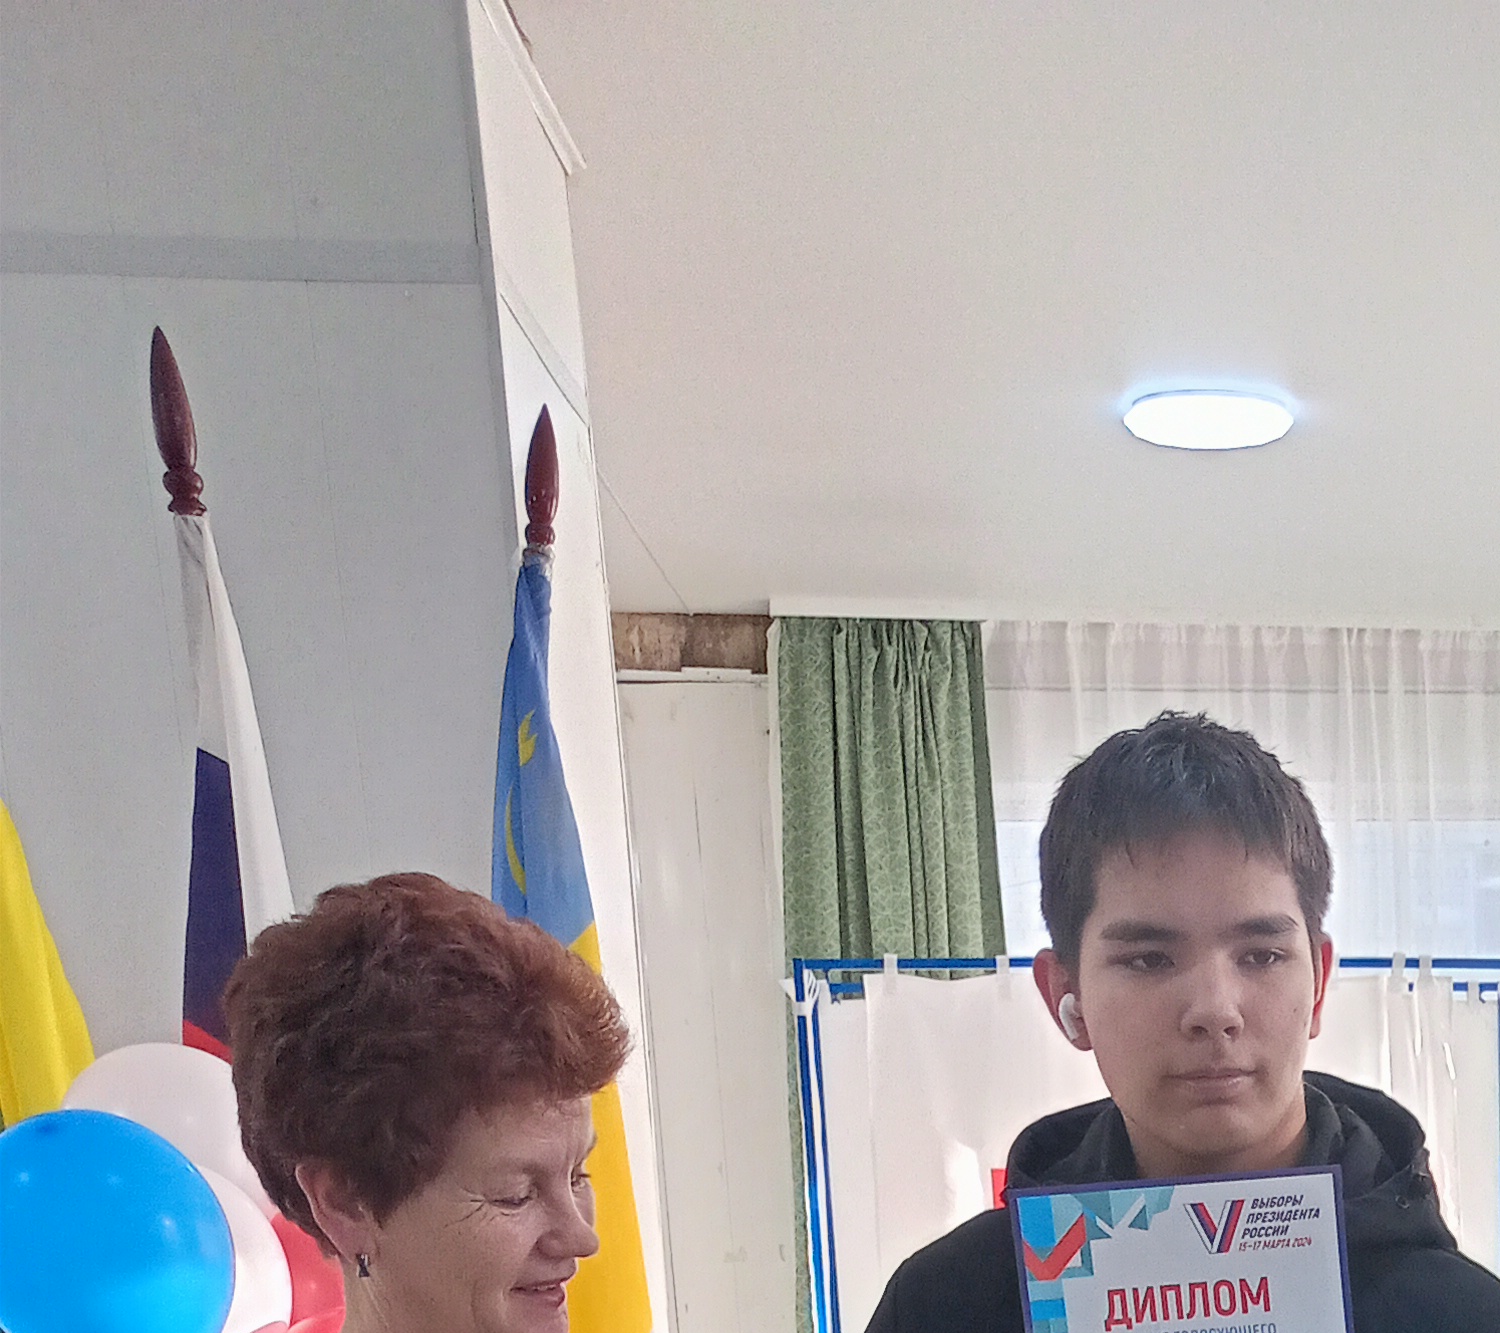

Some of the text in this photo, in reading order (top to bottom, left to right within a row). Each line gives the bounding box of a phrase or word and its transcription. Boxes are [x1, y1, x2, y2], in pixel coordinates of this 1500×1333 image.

[1251, 1195, 1304, 1210] ВЫБОРЫ
[1246, 1208, 1320, 1224] ПРЕЗИДЕНТА
[1241, 1225, 1289, 1239] РОССИИ
[1262, 1238, 1291, 1250] МАРТА
[1292, 1236, 1313, 1248] 2024
[1104, 1276, 1271, 1332] ДИПЛОМ
